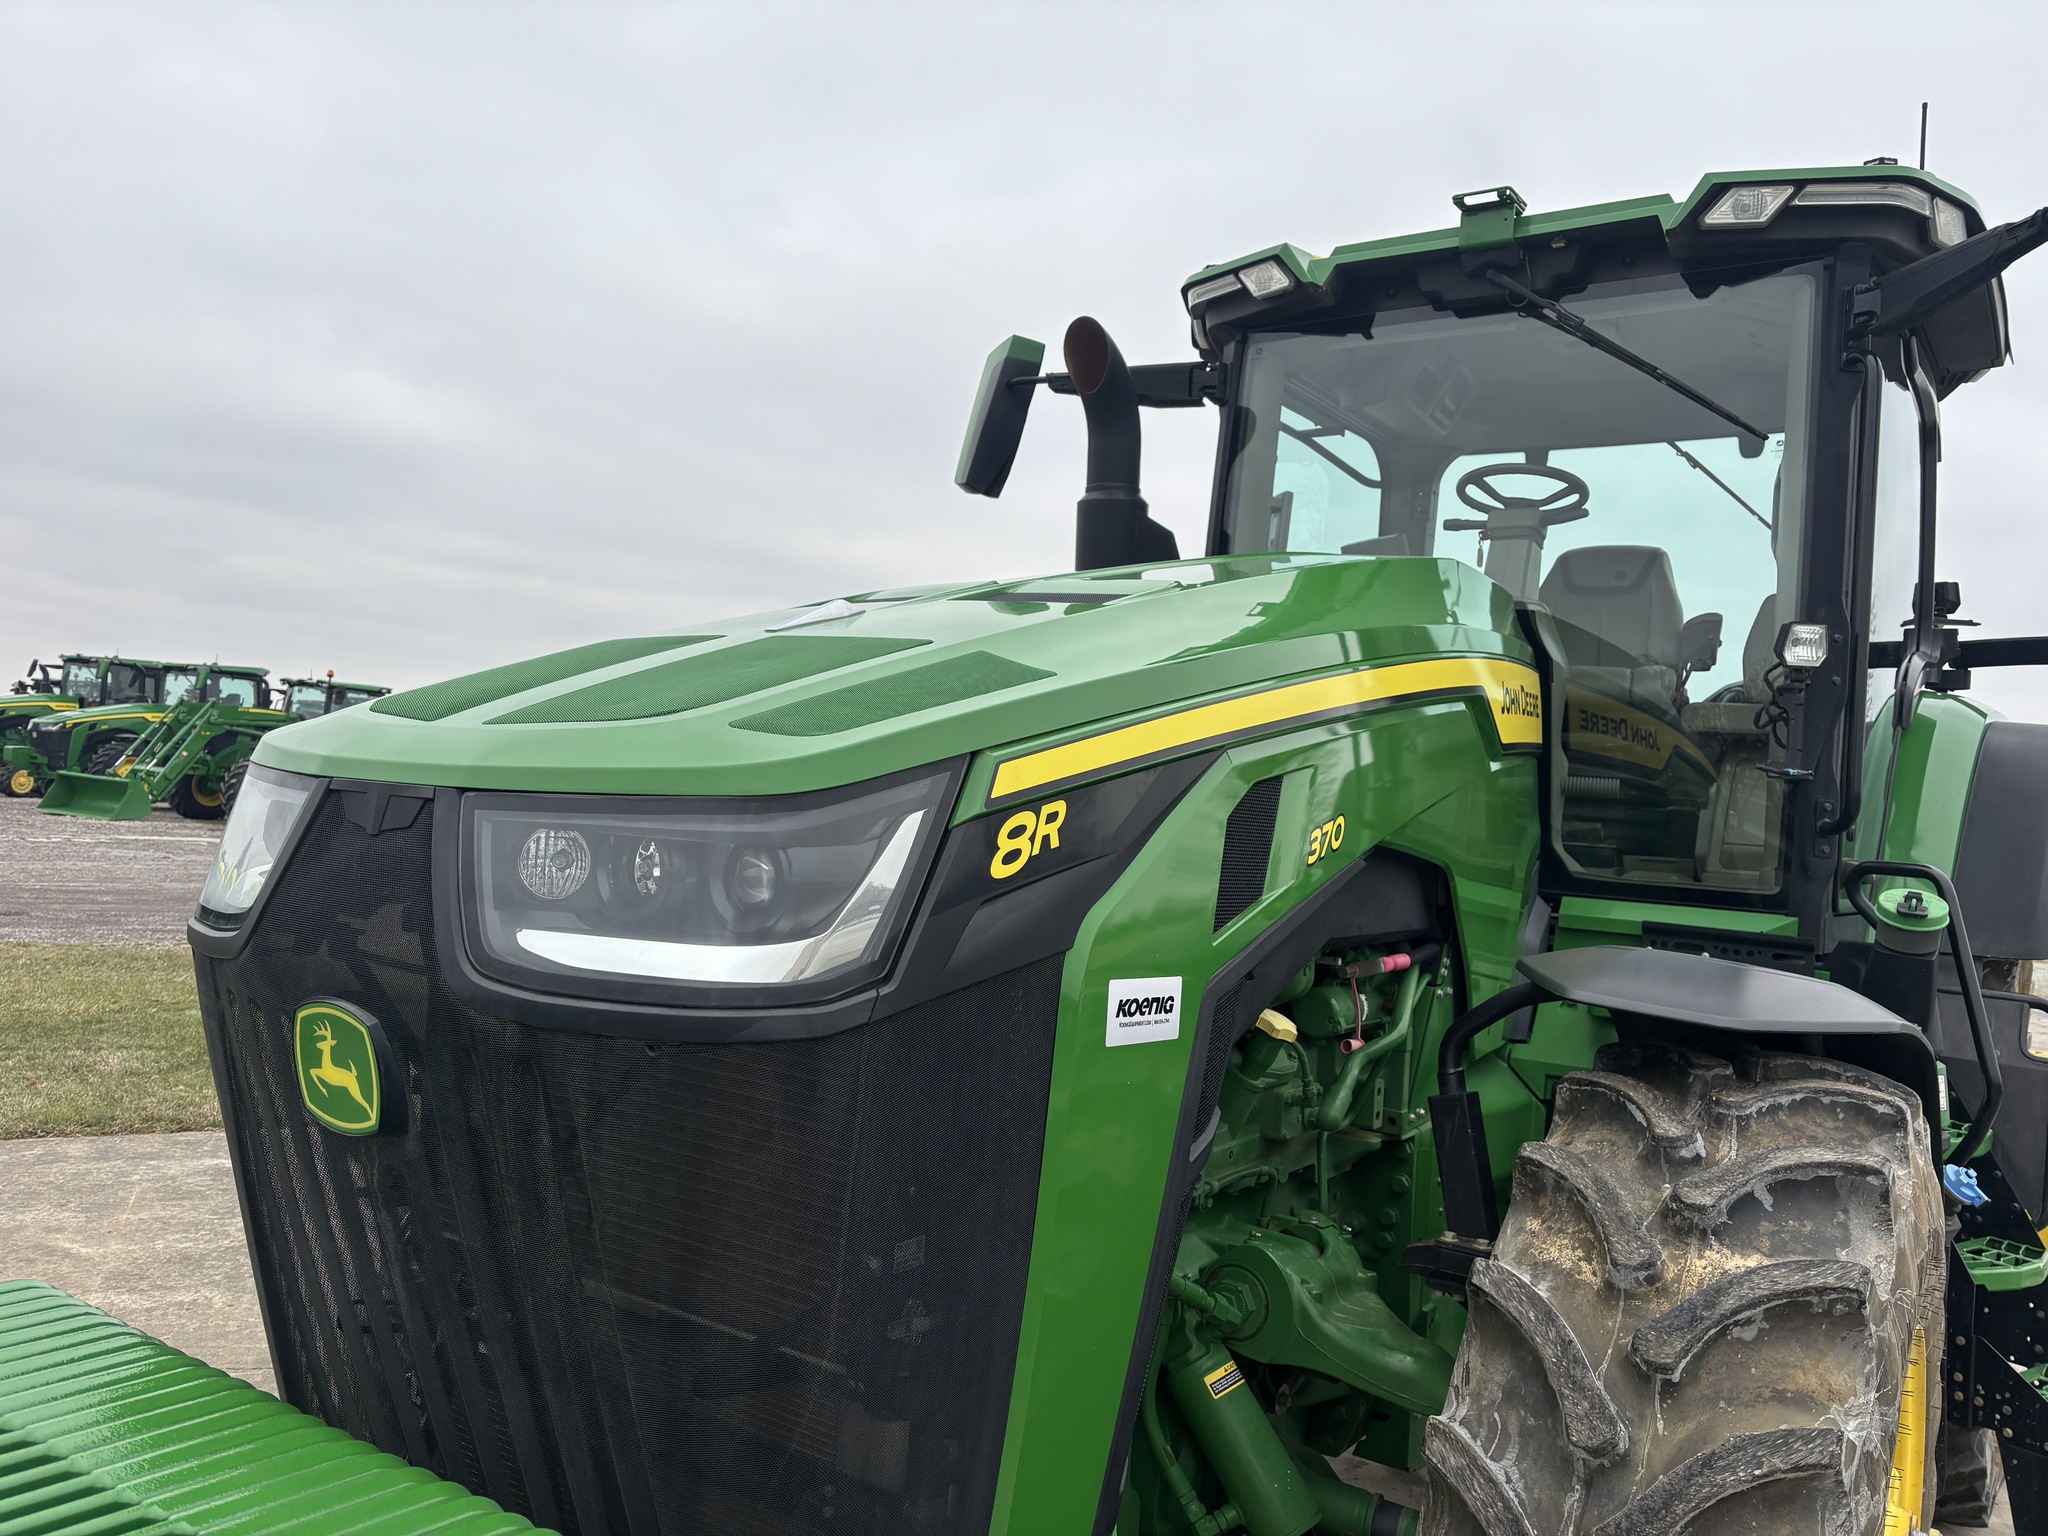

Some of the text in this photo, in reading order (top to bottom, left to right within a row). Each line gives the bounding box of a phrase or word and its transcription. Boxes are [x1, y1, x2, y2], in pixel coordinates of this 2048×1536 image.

[1501, 681, 1539, 718] JOHN DEERE
[990, 800, 1067, 879] 8R
[1307, 814, 1345, 865] 370
